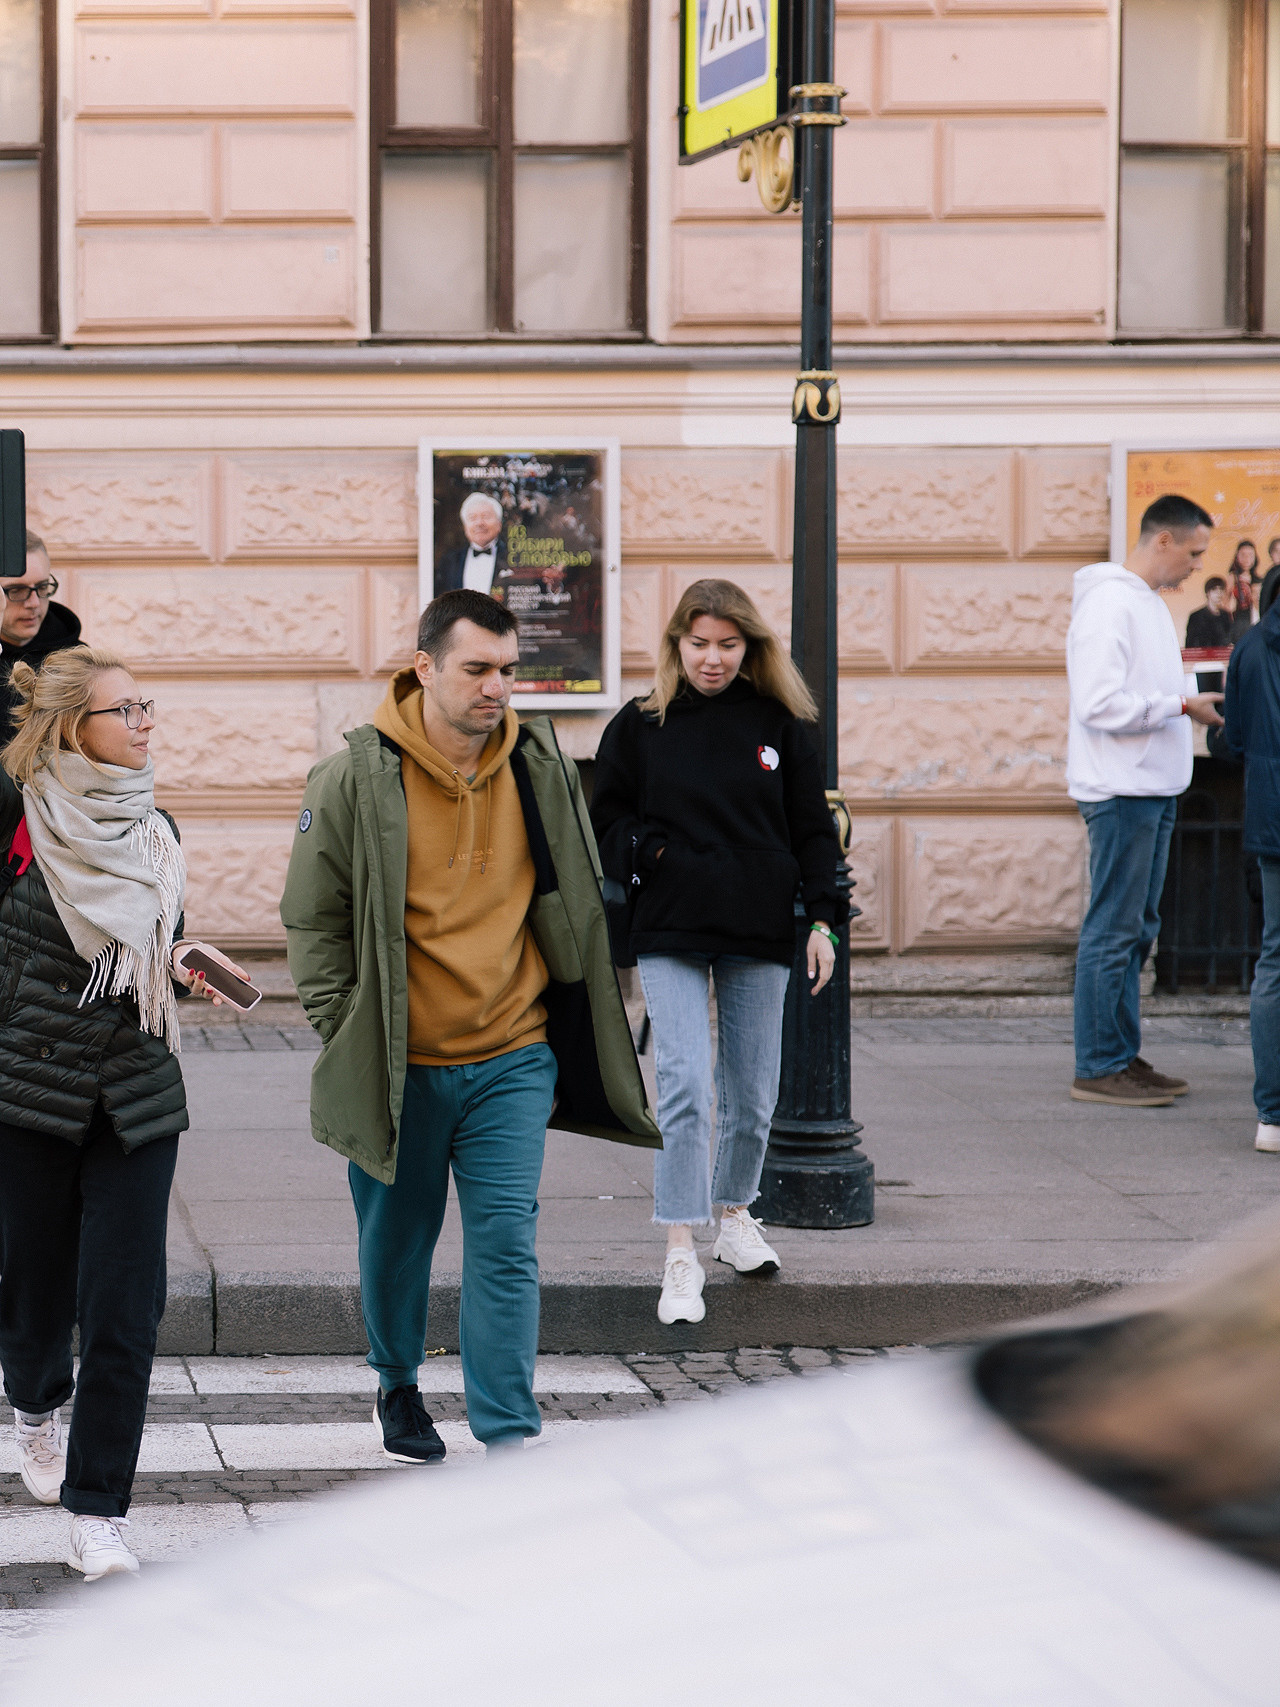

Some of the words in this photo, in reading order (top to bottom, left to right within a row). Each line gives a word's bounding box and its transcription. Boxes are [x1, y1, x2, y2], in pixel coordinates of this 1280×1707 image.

[508, 525, 527, 539] ИЗ
[508, 538, 565, 552] СИБИРИ
[519, 551, 592, 567] ЛЮБОВЬЮ
